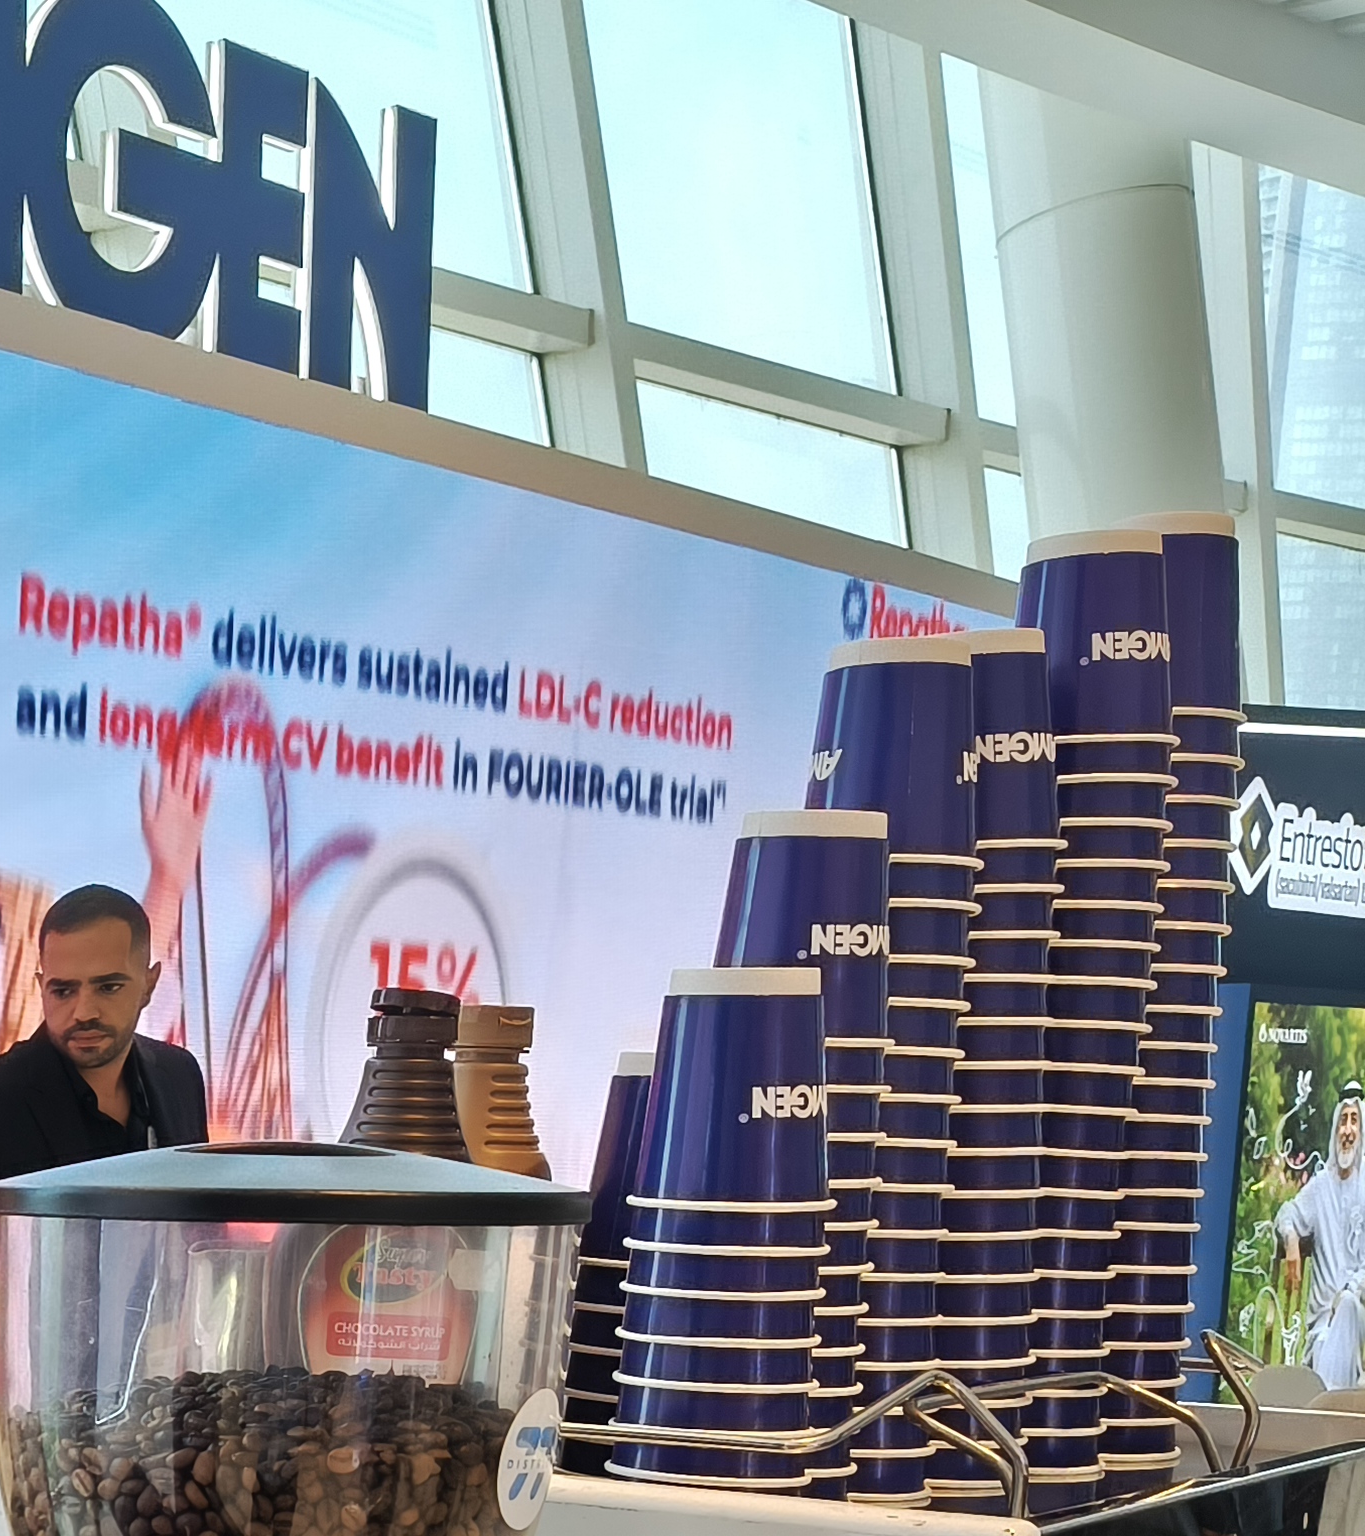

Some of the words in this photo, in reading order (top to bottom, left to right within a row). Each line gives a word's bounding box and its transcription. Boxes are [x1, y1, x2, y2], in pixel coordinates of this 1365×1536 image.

[211, 606, 347, 688] delivers
[356, 645, 510, 714] sustained
[518, 664, 602, 730] LDL-C
[609, 685, 733, 751] reduction
[16, 681, 88, 742] and
[282, 716, 329, 773] CV
[335, 720, 444, 790] benefit
[452, 735, 478, 795] in
[975, 731, 1057, 763] MGEN
[1279, 818, 1364, 872] Entresto
[334, 1321, 408, 1337] CHOCOLATE
[410, 1324, 446, 1339] SYRUP
